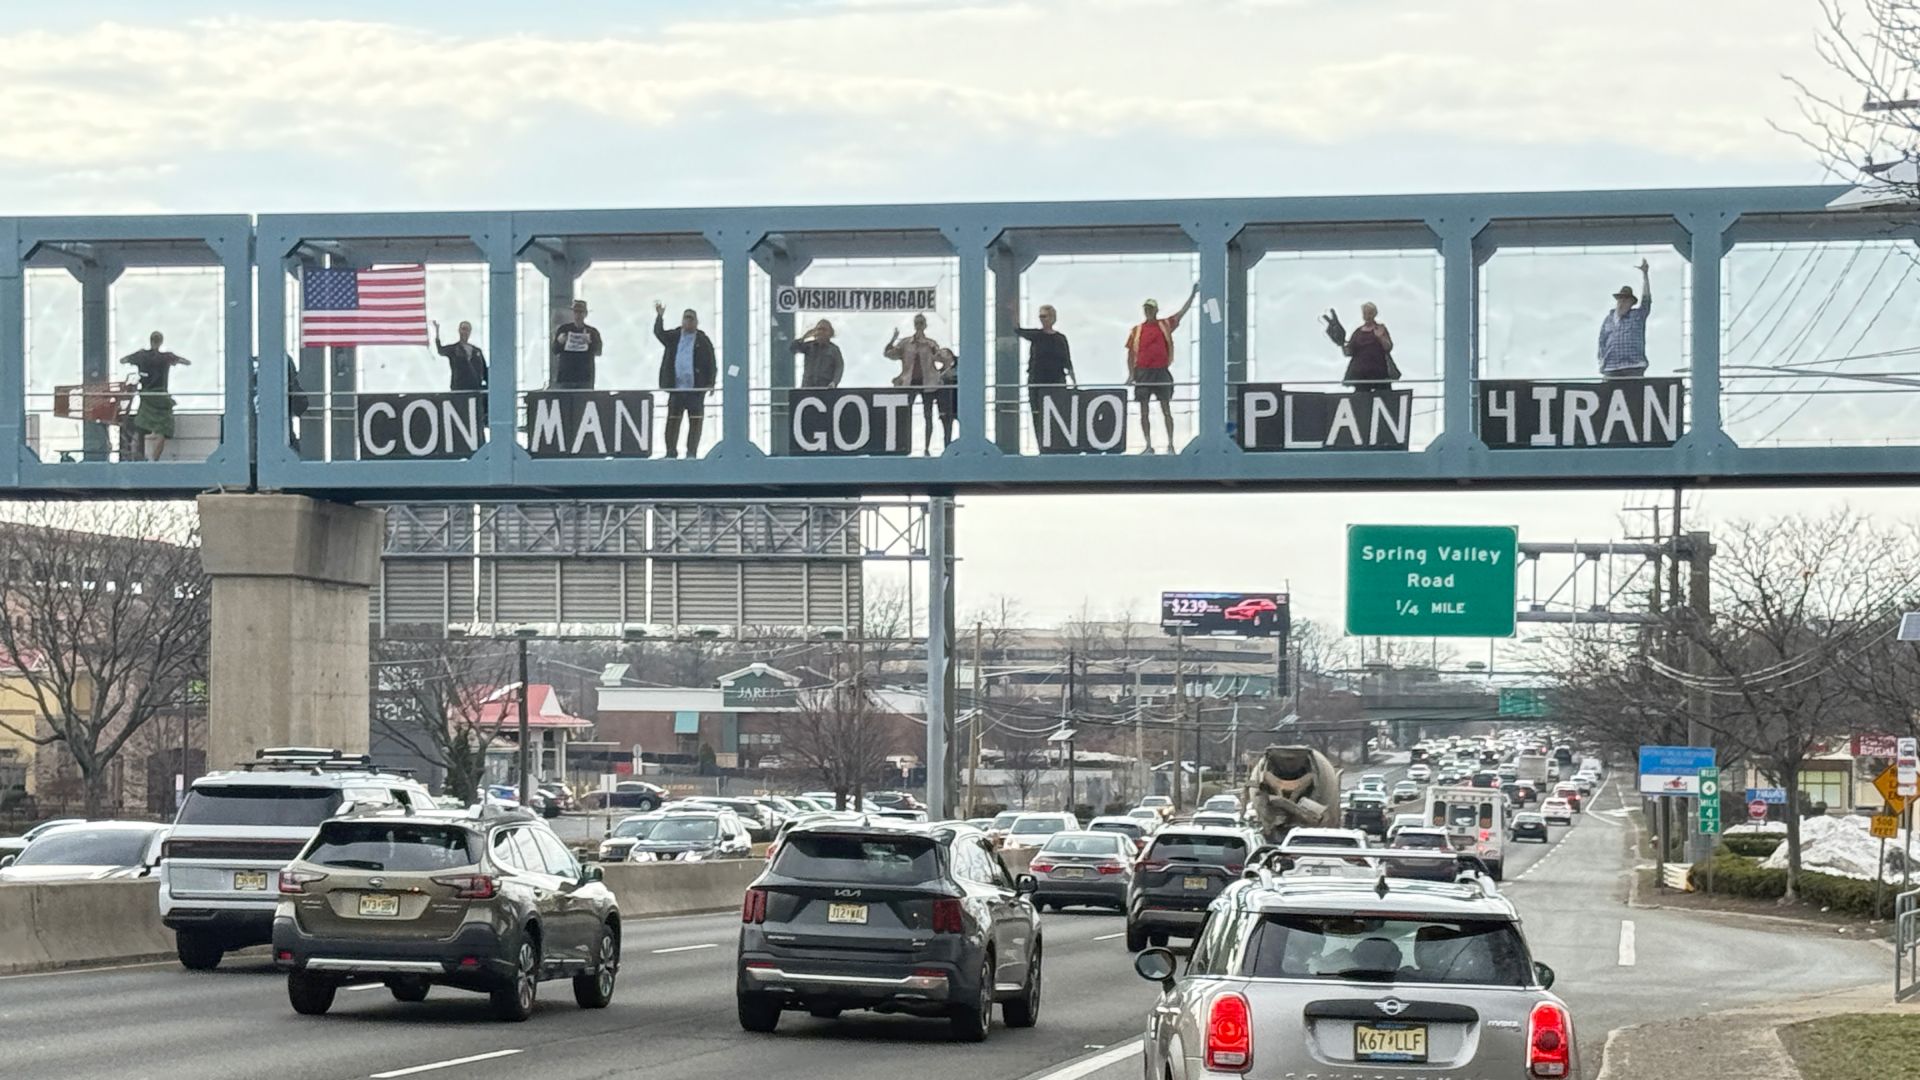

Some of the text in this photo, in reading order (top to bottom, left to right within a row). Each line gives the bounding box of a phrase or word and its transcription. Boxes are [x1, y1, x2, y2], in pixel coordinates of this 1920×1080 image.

[778, 289, 936, 310] @VISIBILITYBRIGADE
[362, 395, 479, 457] CON
[531, 398, 651, 454] MAN
[792, 393, 910, 453] GOT
[1042, 394, 1125, 452] NO
[1244, 391, 1410, 449] PLAN
[1361, 546, 1502, 565] Spring Valley
[1407, 573, 1455, 588] Road
[1171, 599, 1208, 613] $239
[1431, 602, 1466, 614] MILE
[1700, 799, 1718, 807] MILE
[1705, 808, 1713, 819] 4
[1706, 822, 1714, 832] 2
